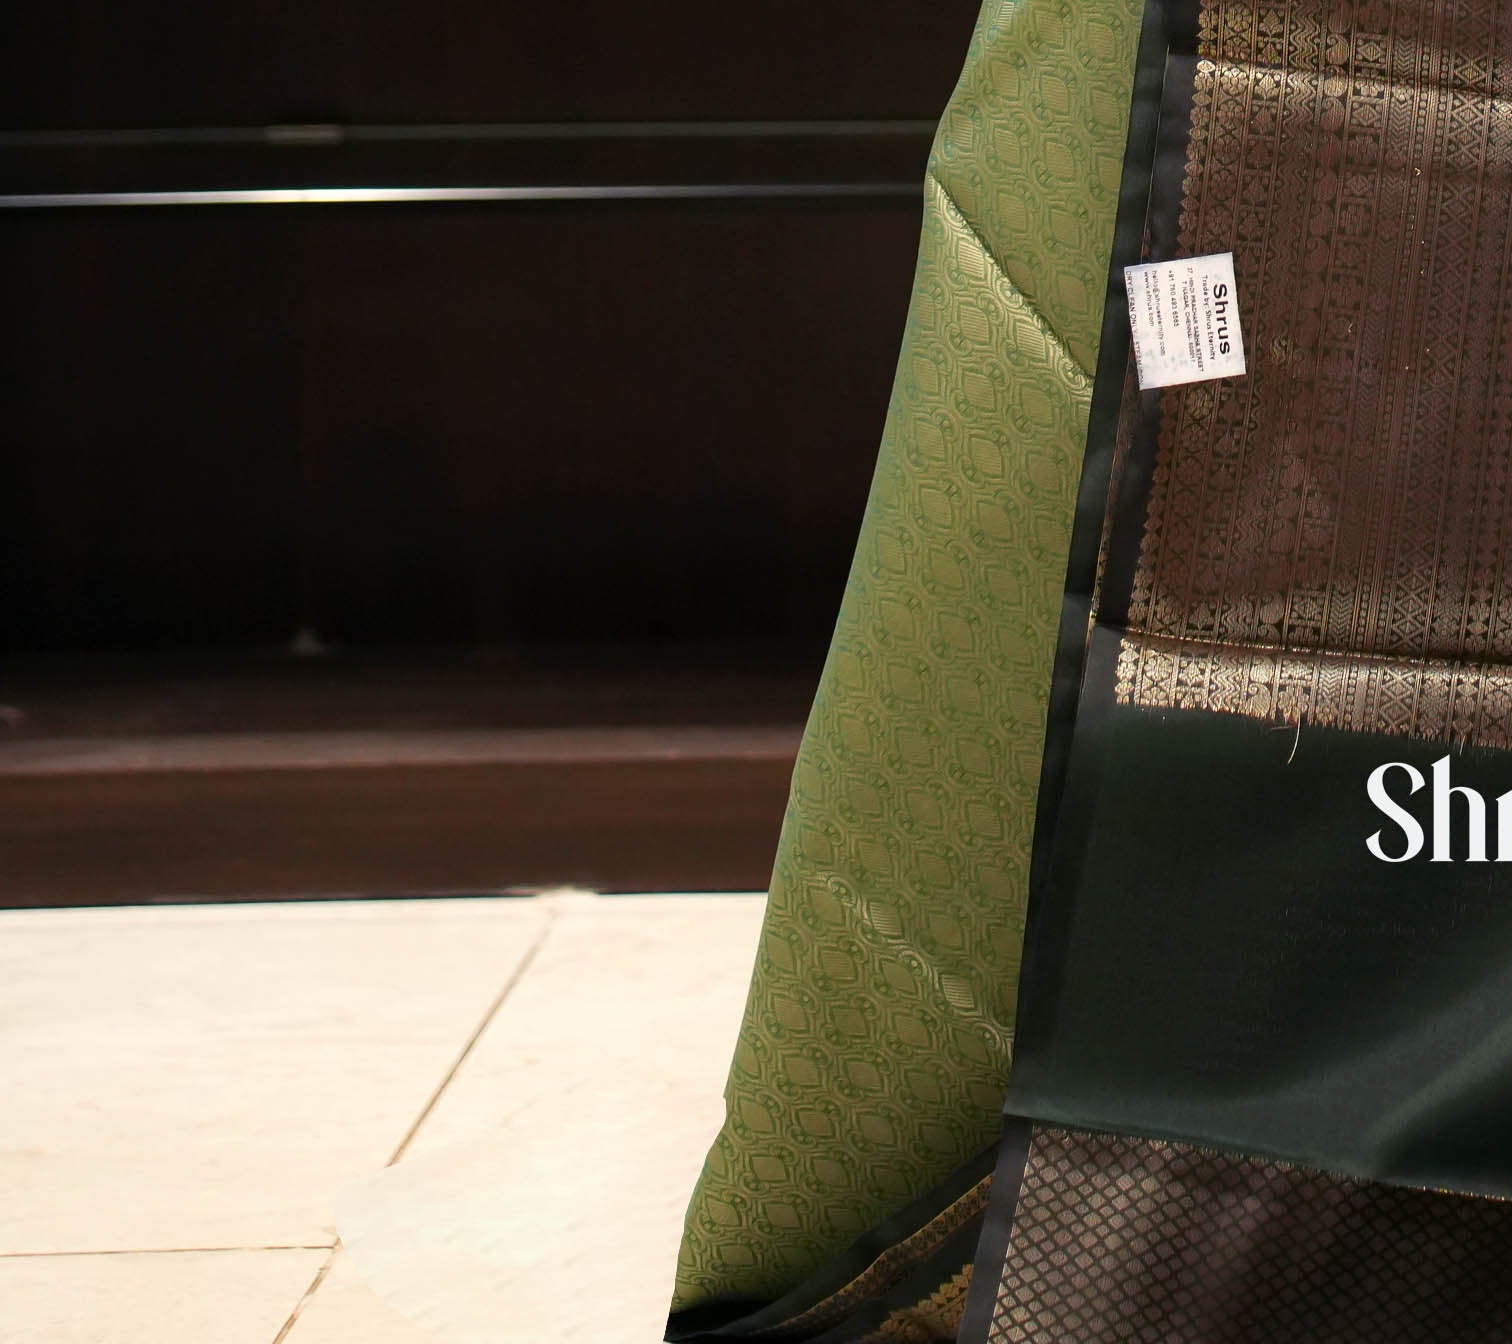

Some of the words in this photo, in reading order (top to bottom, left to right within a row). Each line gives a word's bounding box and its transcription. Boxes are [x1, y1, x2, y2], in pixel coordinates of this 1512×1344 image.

[1201, 274, 1209, 295] Trade
[1202, 297, 1210, 308] by:
[1213, 283, 1230, 355] Shrus
[1207, 332, 1215, 360] Eternity
